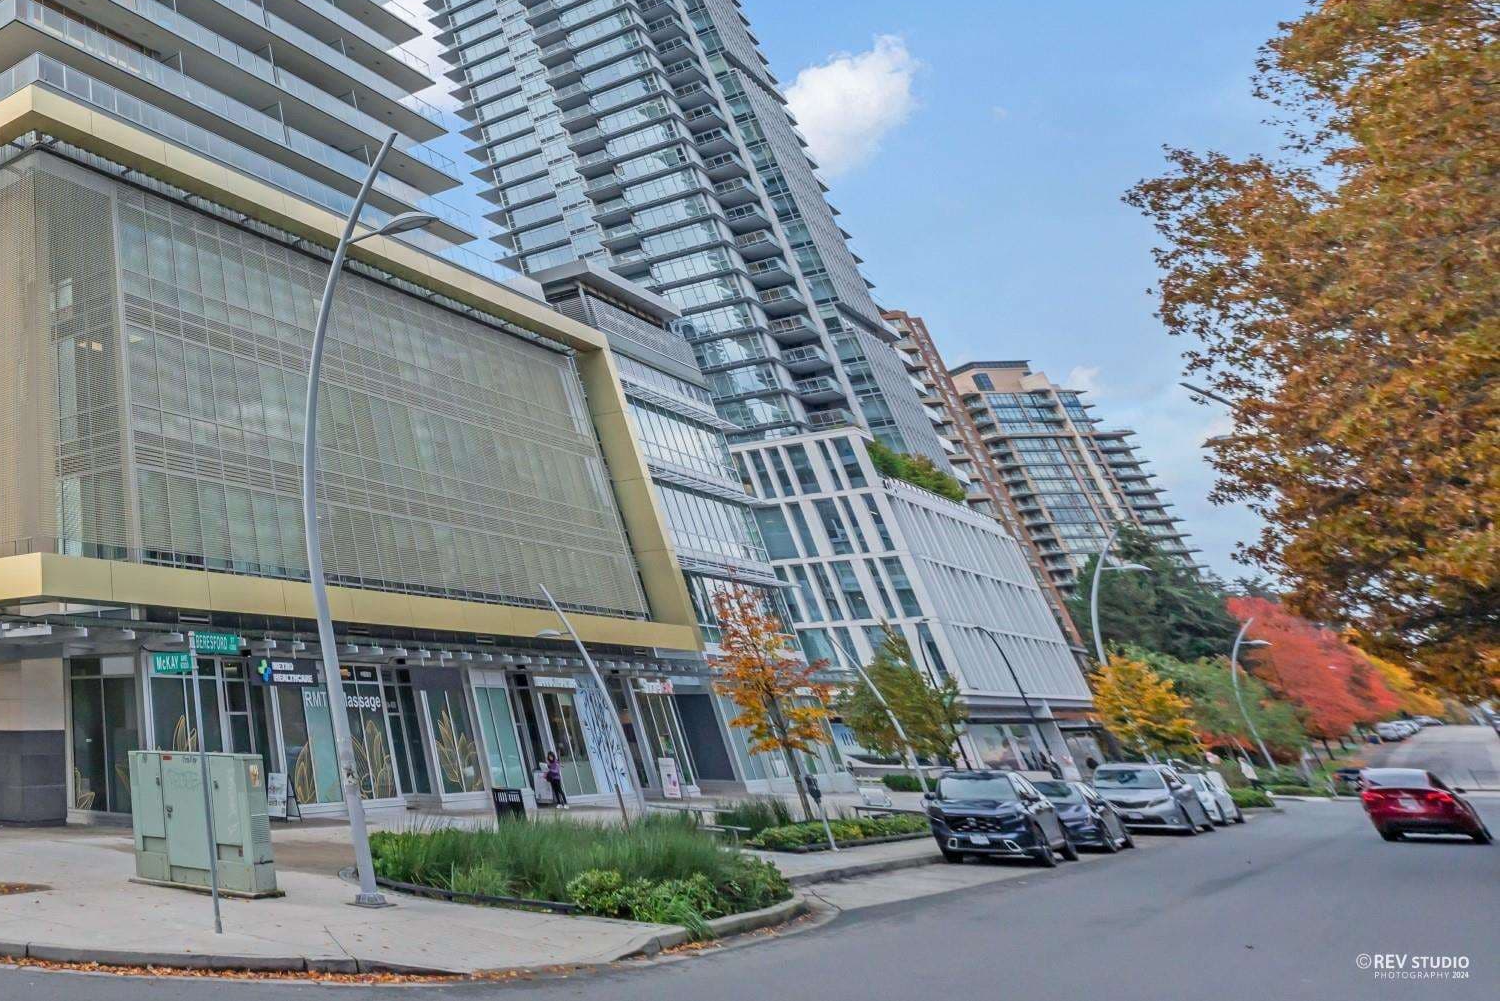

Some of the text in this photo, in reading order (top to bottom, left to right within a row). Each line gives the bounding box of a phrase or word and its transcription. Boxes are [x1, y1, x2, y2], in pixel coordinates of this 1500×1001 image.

[196, 634, 228, 650] BERESFORD
[156, 655, 179, 670] McKAY
[271, 661, 294, 671] METRO
[273, 673, 314, 683] HEALTHCARE
[304, 690, 328, 708] RMT
